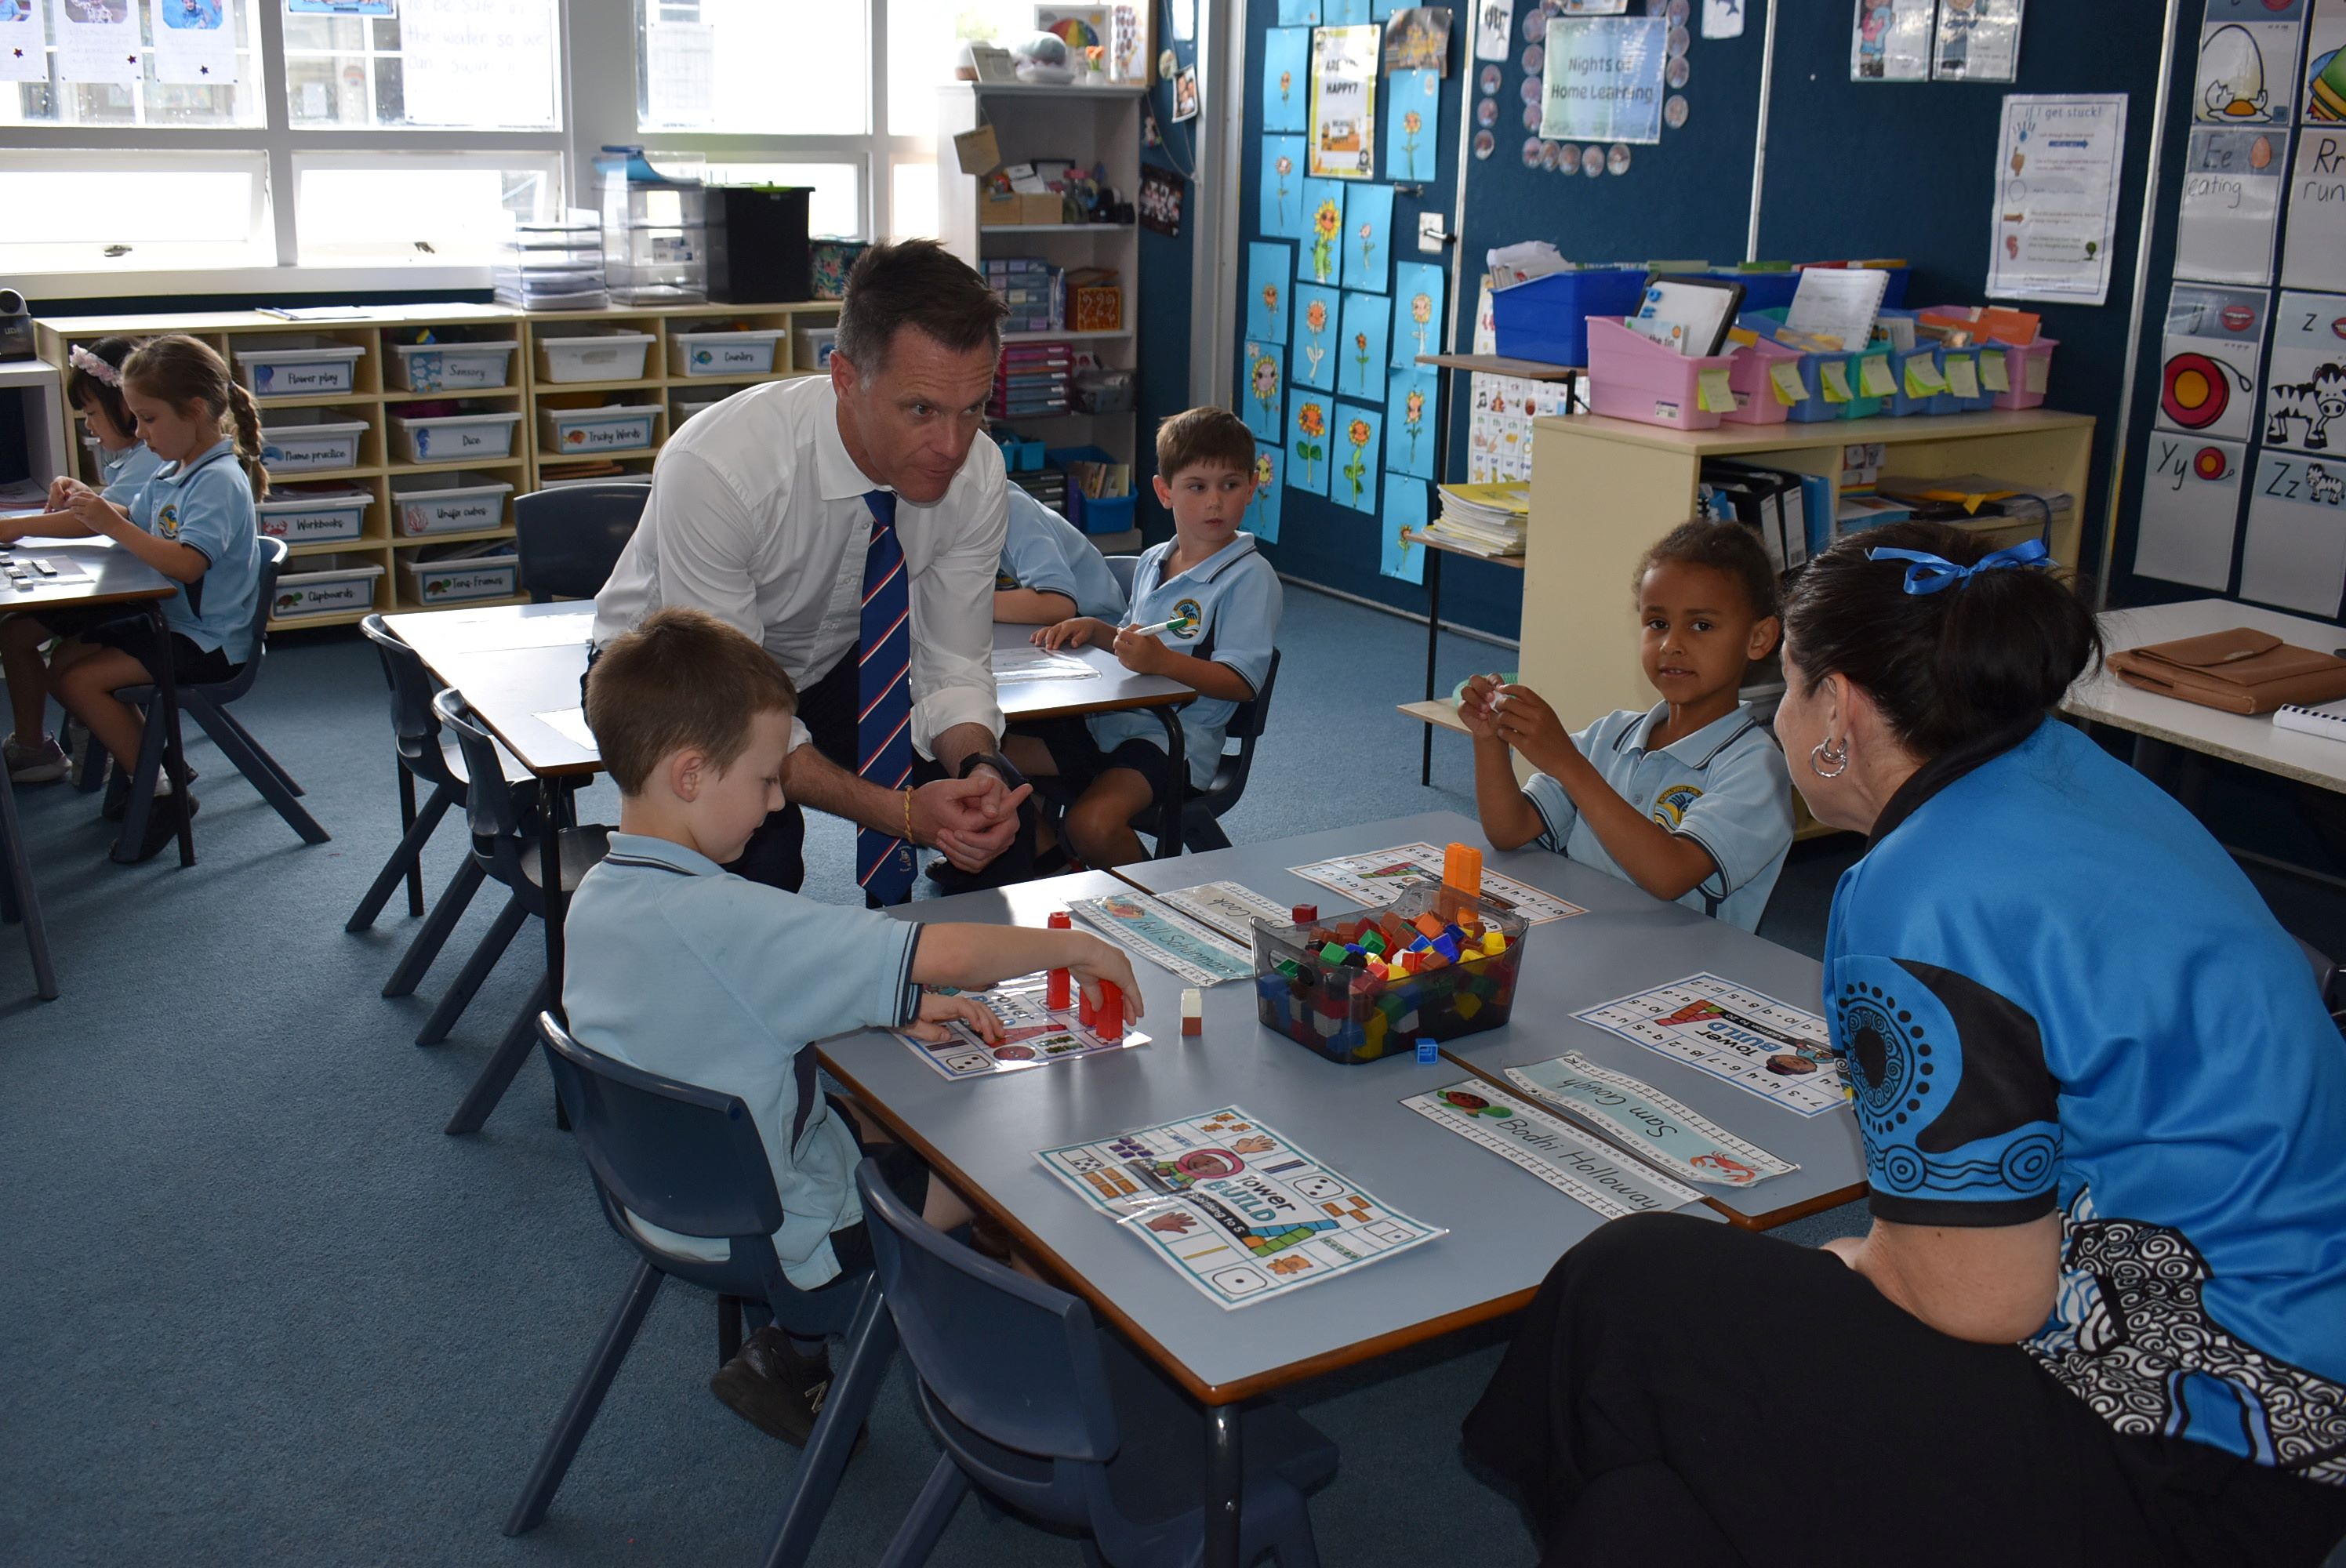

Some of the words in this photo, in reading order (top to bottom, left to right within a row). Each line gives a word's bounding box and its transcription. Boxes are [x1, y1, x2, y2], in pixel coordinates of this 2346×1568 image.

[497, 34, 514, 47] so
[1568, 55, 1612, 75] Nights
[1551, 84, 1587, 100] Home
[1591, 85, 1653, 104] Learning
[2045, 107, 2063, 121] get
[2068, 106, 2101, 118] stuck!
[2203, 134, 2233, 169] Ee
[2188, 176, 2242, 209] eating
[2303, 181, 2346, 202] run
[289, 372, 315, 384] Flower
[319, 372, 339, 385] play
[449, 365, 486, 381] Sensory
[463, 434, 481, 446] Dice
[589, 431, 614, 443] Tricky
[617, 429, 641, 440] Words
[285, 449, 310, 461] Name
[312, 448, 346, 463] practice
[2156, 441, 2188, 491] Yy
[2265, 462, 2301, 499] Zz
[437, 508, 461, 521] Unifix
[464, 507, 487, 517] cubes
[297, 518, 343, 531] Workbooks
[308, 588, 354, 602] Clipboards
[1208, 898, 1251, 916] Cook
[1708, 1022, 1783, 1053] BUILD
[1751, 1024, 1789, 1040] Addition
[1694, 1029, 1758, 1057] Tower
[1556, 1079, 1627, 1105] Gough
[1629, 1107, 1678, 1138] Sam
[1495, 1119, 1564, 1151] Bodhi
[1558, 1151, 1662, 1212] Holloway
[1203, 1180, 1276, 1221] BUILD
[1236, 1174, 1296, 1212] Tower
[1223, 1217, 1236, 1227] to
